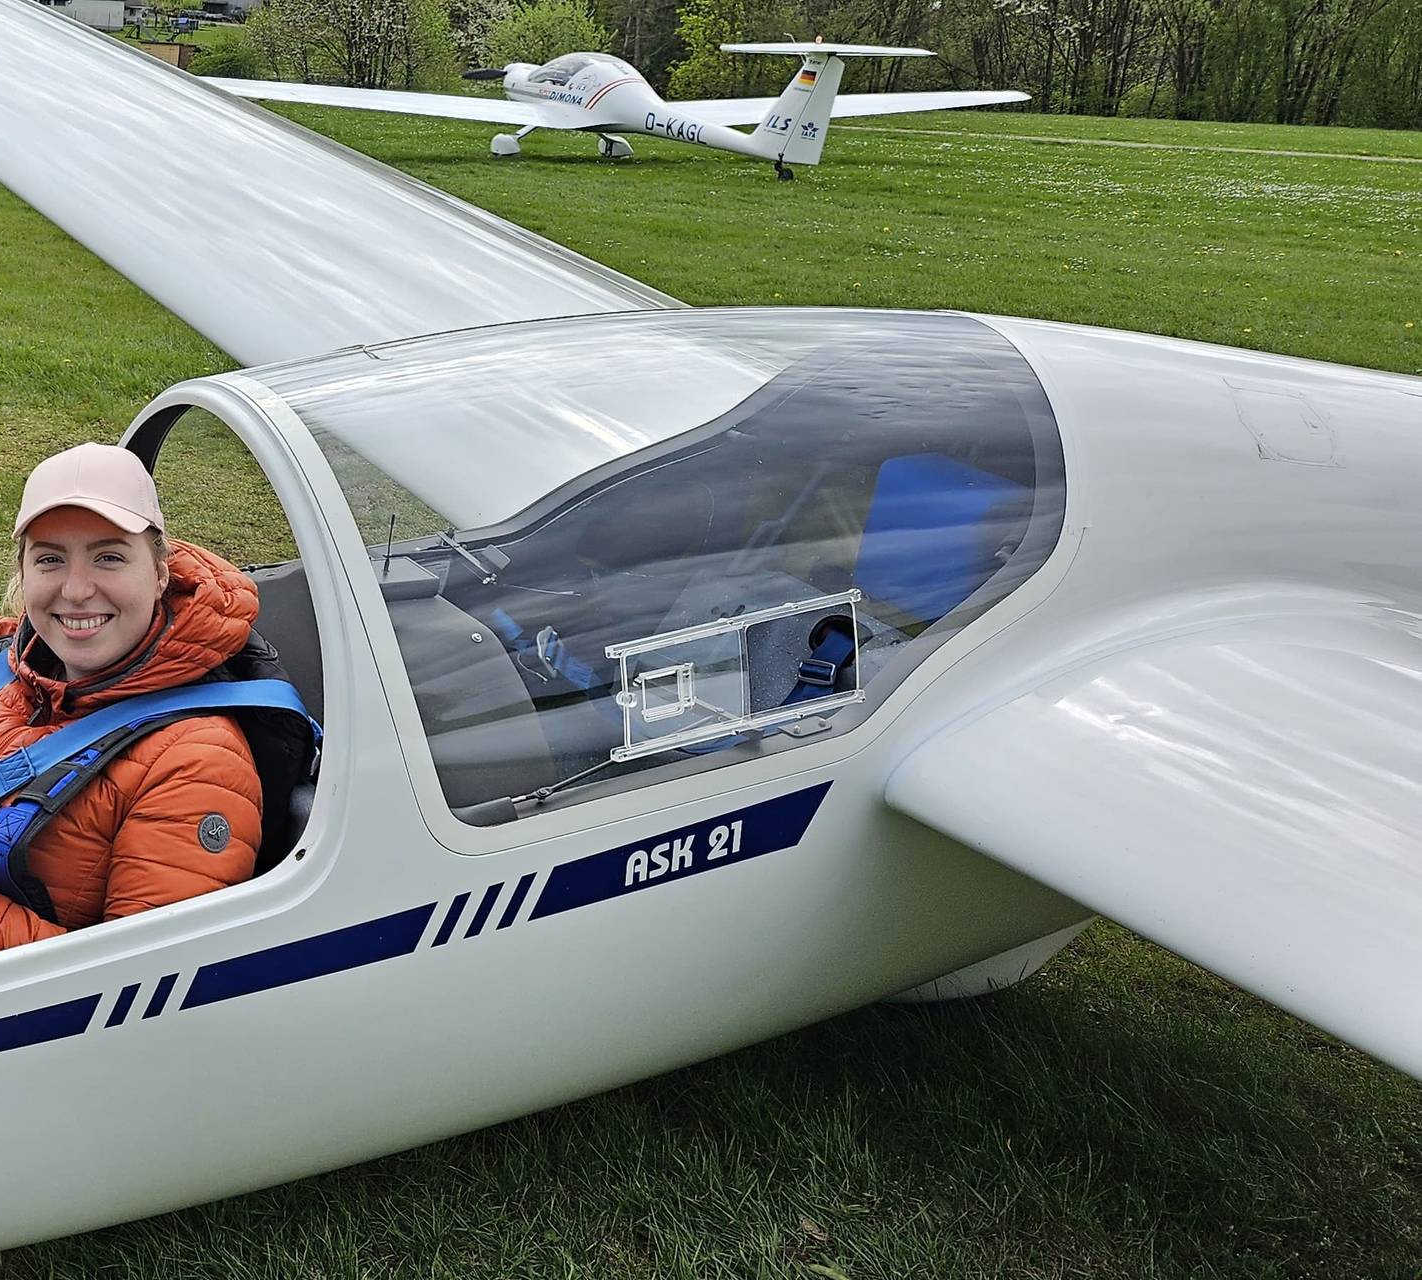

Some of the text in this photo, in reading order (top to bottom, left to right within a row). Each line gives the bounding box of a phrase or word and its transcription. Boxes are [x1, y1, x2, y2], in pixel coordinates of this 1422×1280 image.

[549, 91, 583, 105] DIMONA
[645, 112, 706, 144] D-KAGL
[766, 115, 792, 131] ILS
[625, 820, 742, 887] ASK 21
